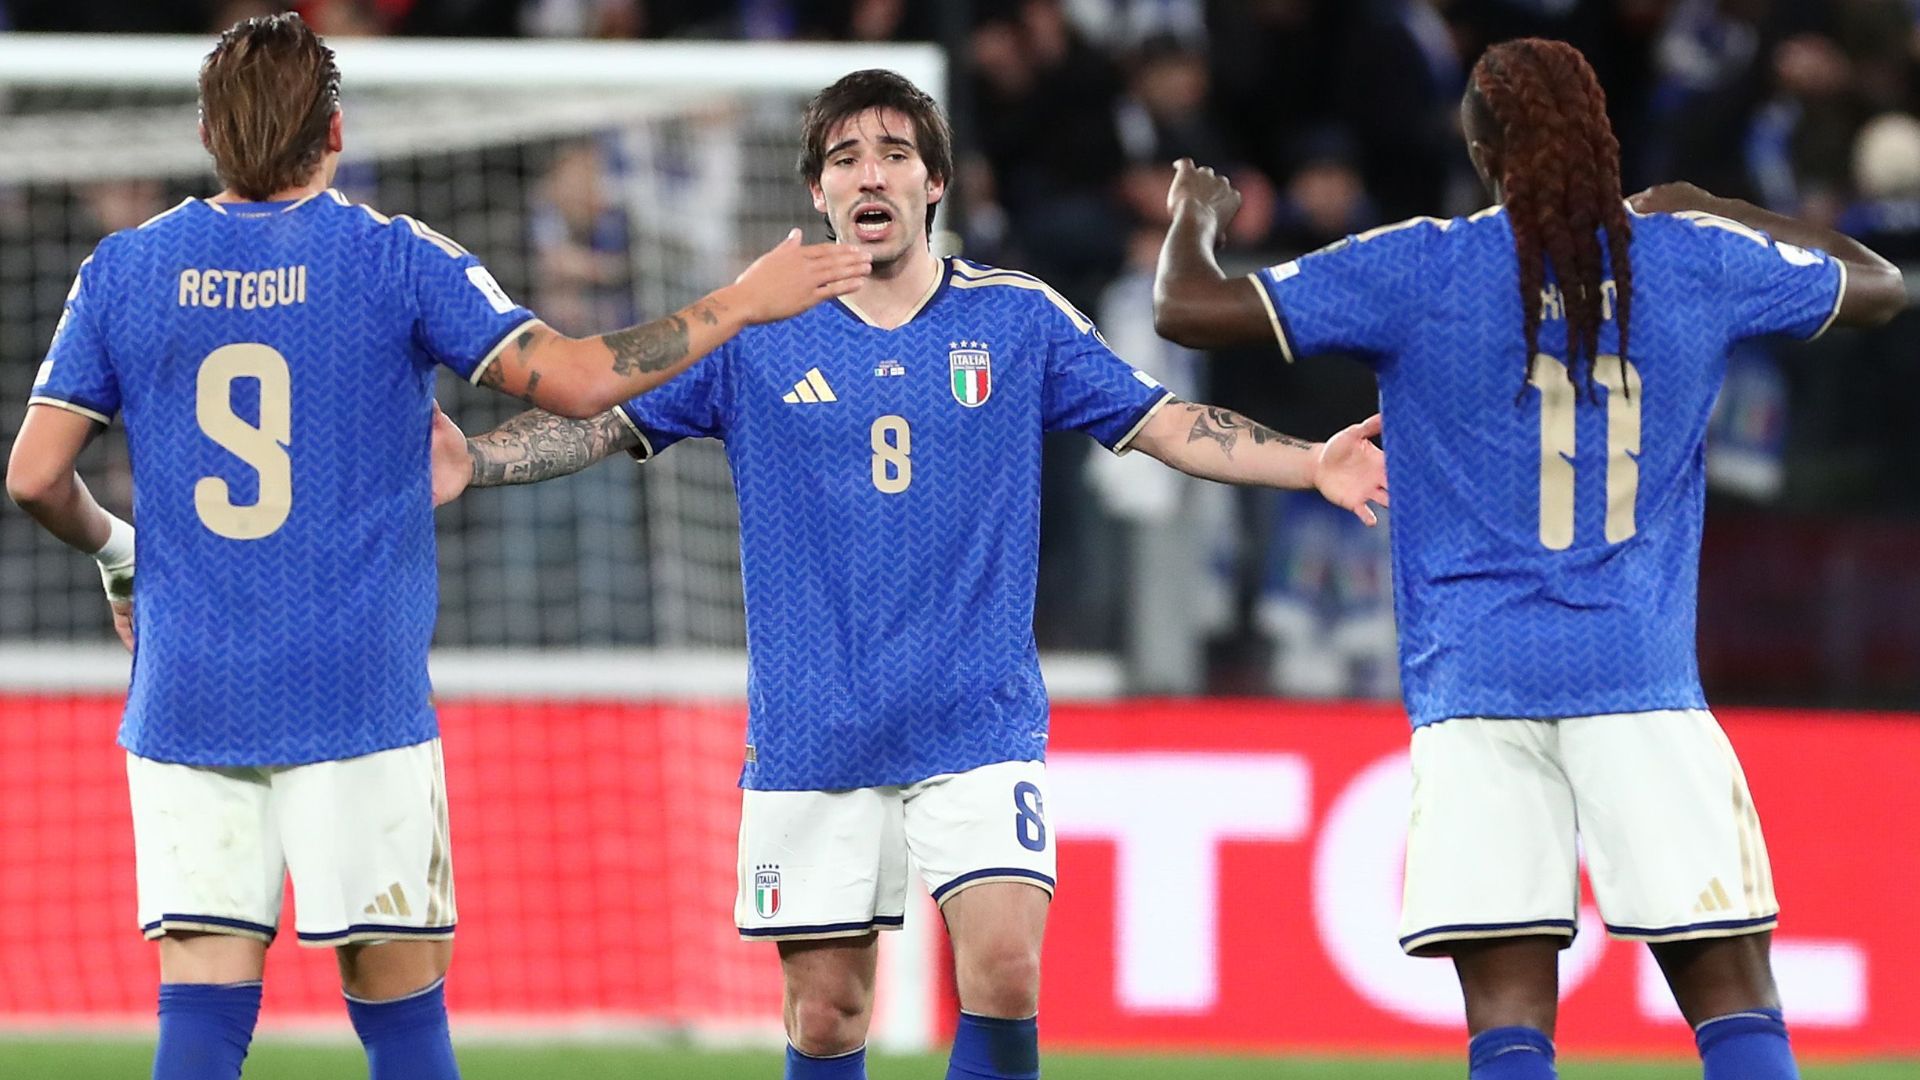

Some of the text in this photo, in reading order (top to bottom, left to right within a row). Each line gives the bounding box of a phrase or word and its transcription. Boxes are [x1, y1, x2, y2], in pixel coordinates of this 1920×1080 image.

[178, 265, 306, 310] RETEGUI
[953, 354, 987, 366] ITALIA
[194, 342, 292, 540] 9
[870, 414, 912, 494] 8
[1526, 354, 1642, 550] 11
[1013, 780, 1047, 852] 8
[757, 875, 778, 885] ITALIA
